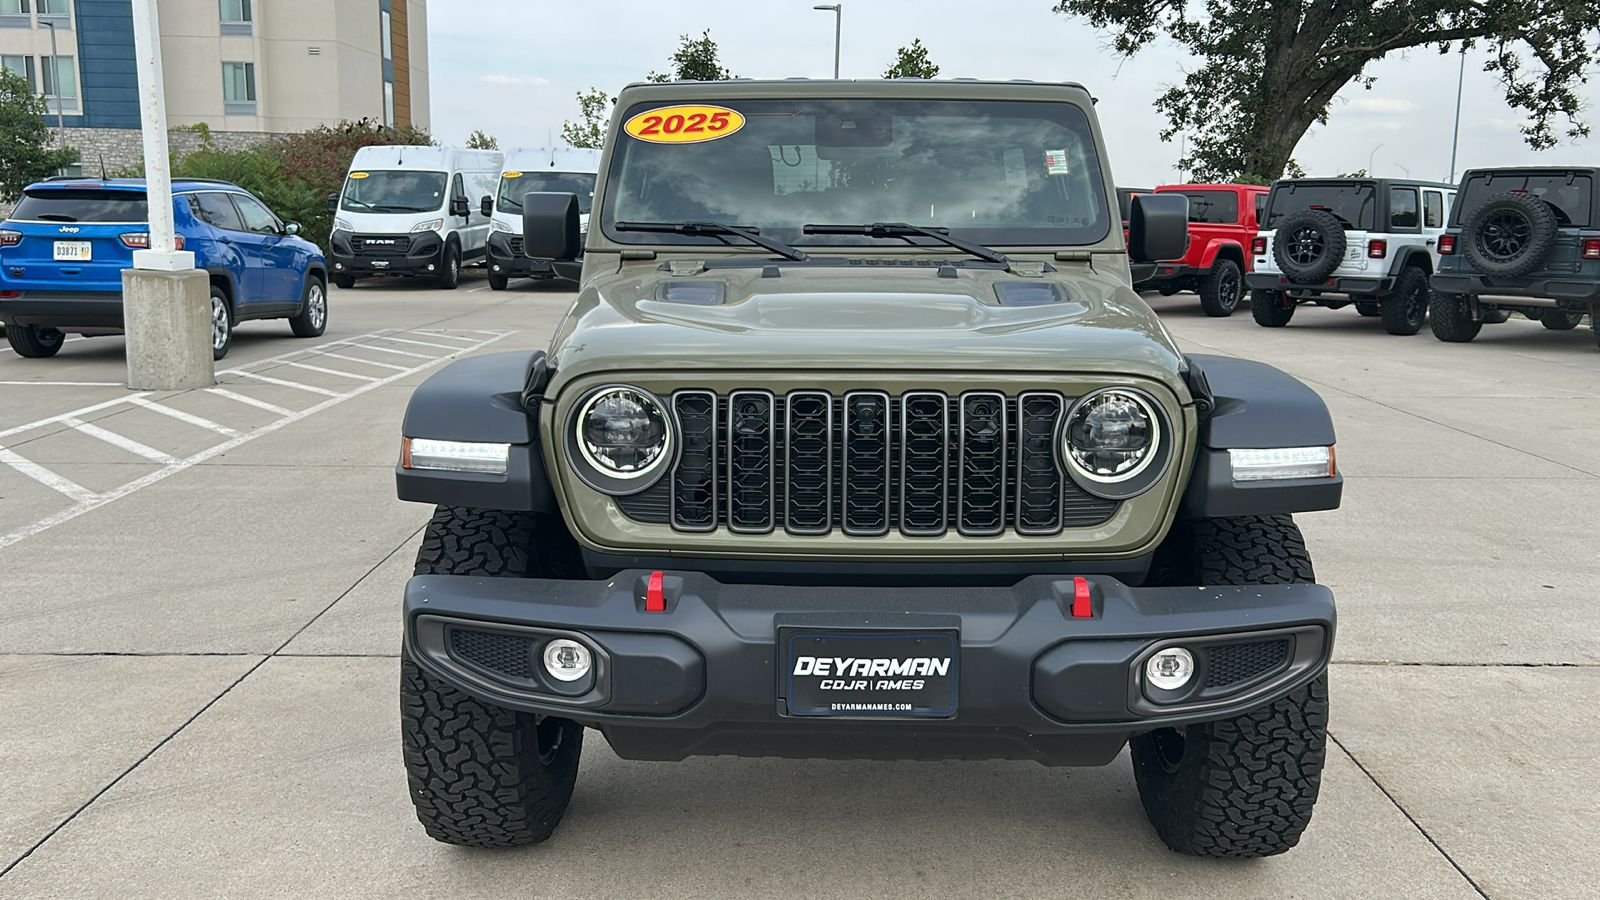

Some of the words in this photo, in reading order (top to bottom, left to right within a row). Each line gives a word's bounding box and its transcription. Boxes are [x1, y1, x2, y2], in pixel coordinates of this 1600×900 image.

[638, 112, 731, 135] 2025
[793, 656, 951, 677] DEYARMAN
[819, 679, 866, 690] CDJR
[875, 679, 925, 690] AMES
[831, 703, 912, 711] DEYARMANAMES.COM
